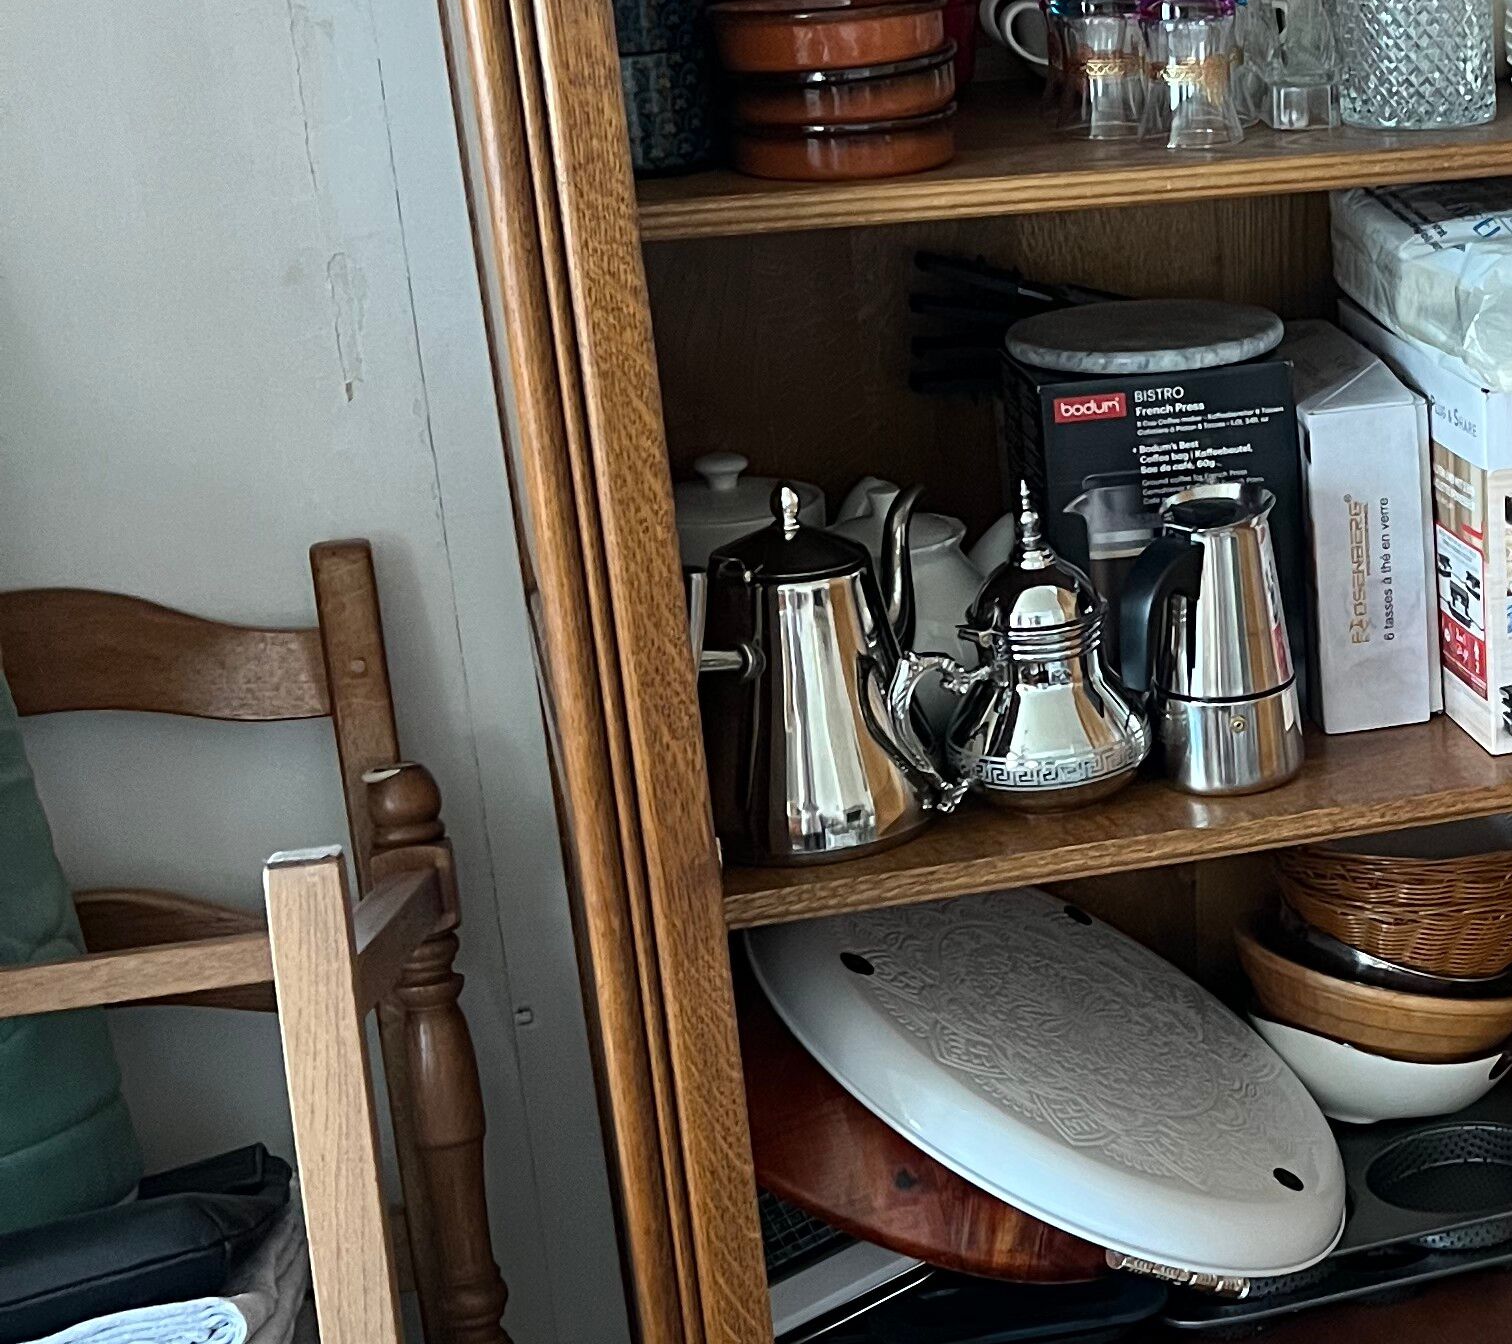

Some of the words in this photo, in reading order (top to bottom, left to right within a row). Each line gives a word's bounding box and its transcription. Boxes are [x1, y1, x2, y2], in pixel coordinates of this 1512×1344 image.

[1134, 386, 1185, 403] BISTRO
[1060, 398, 1120, 417] bodum
[1135, 404, 1174, 417] French
[1175, 402, 1205, 414] Press
[1379, 497, 1391, 531] verre
[1380, 534, 1391, 550] en
[1383, 589, 1395, 630] tasses
[1383, 632, 1395, 641] 6
